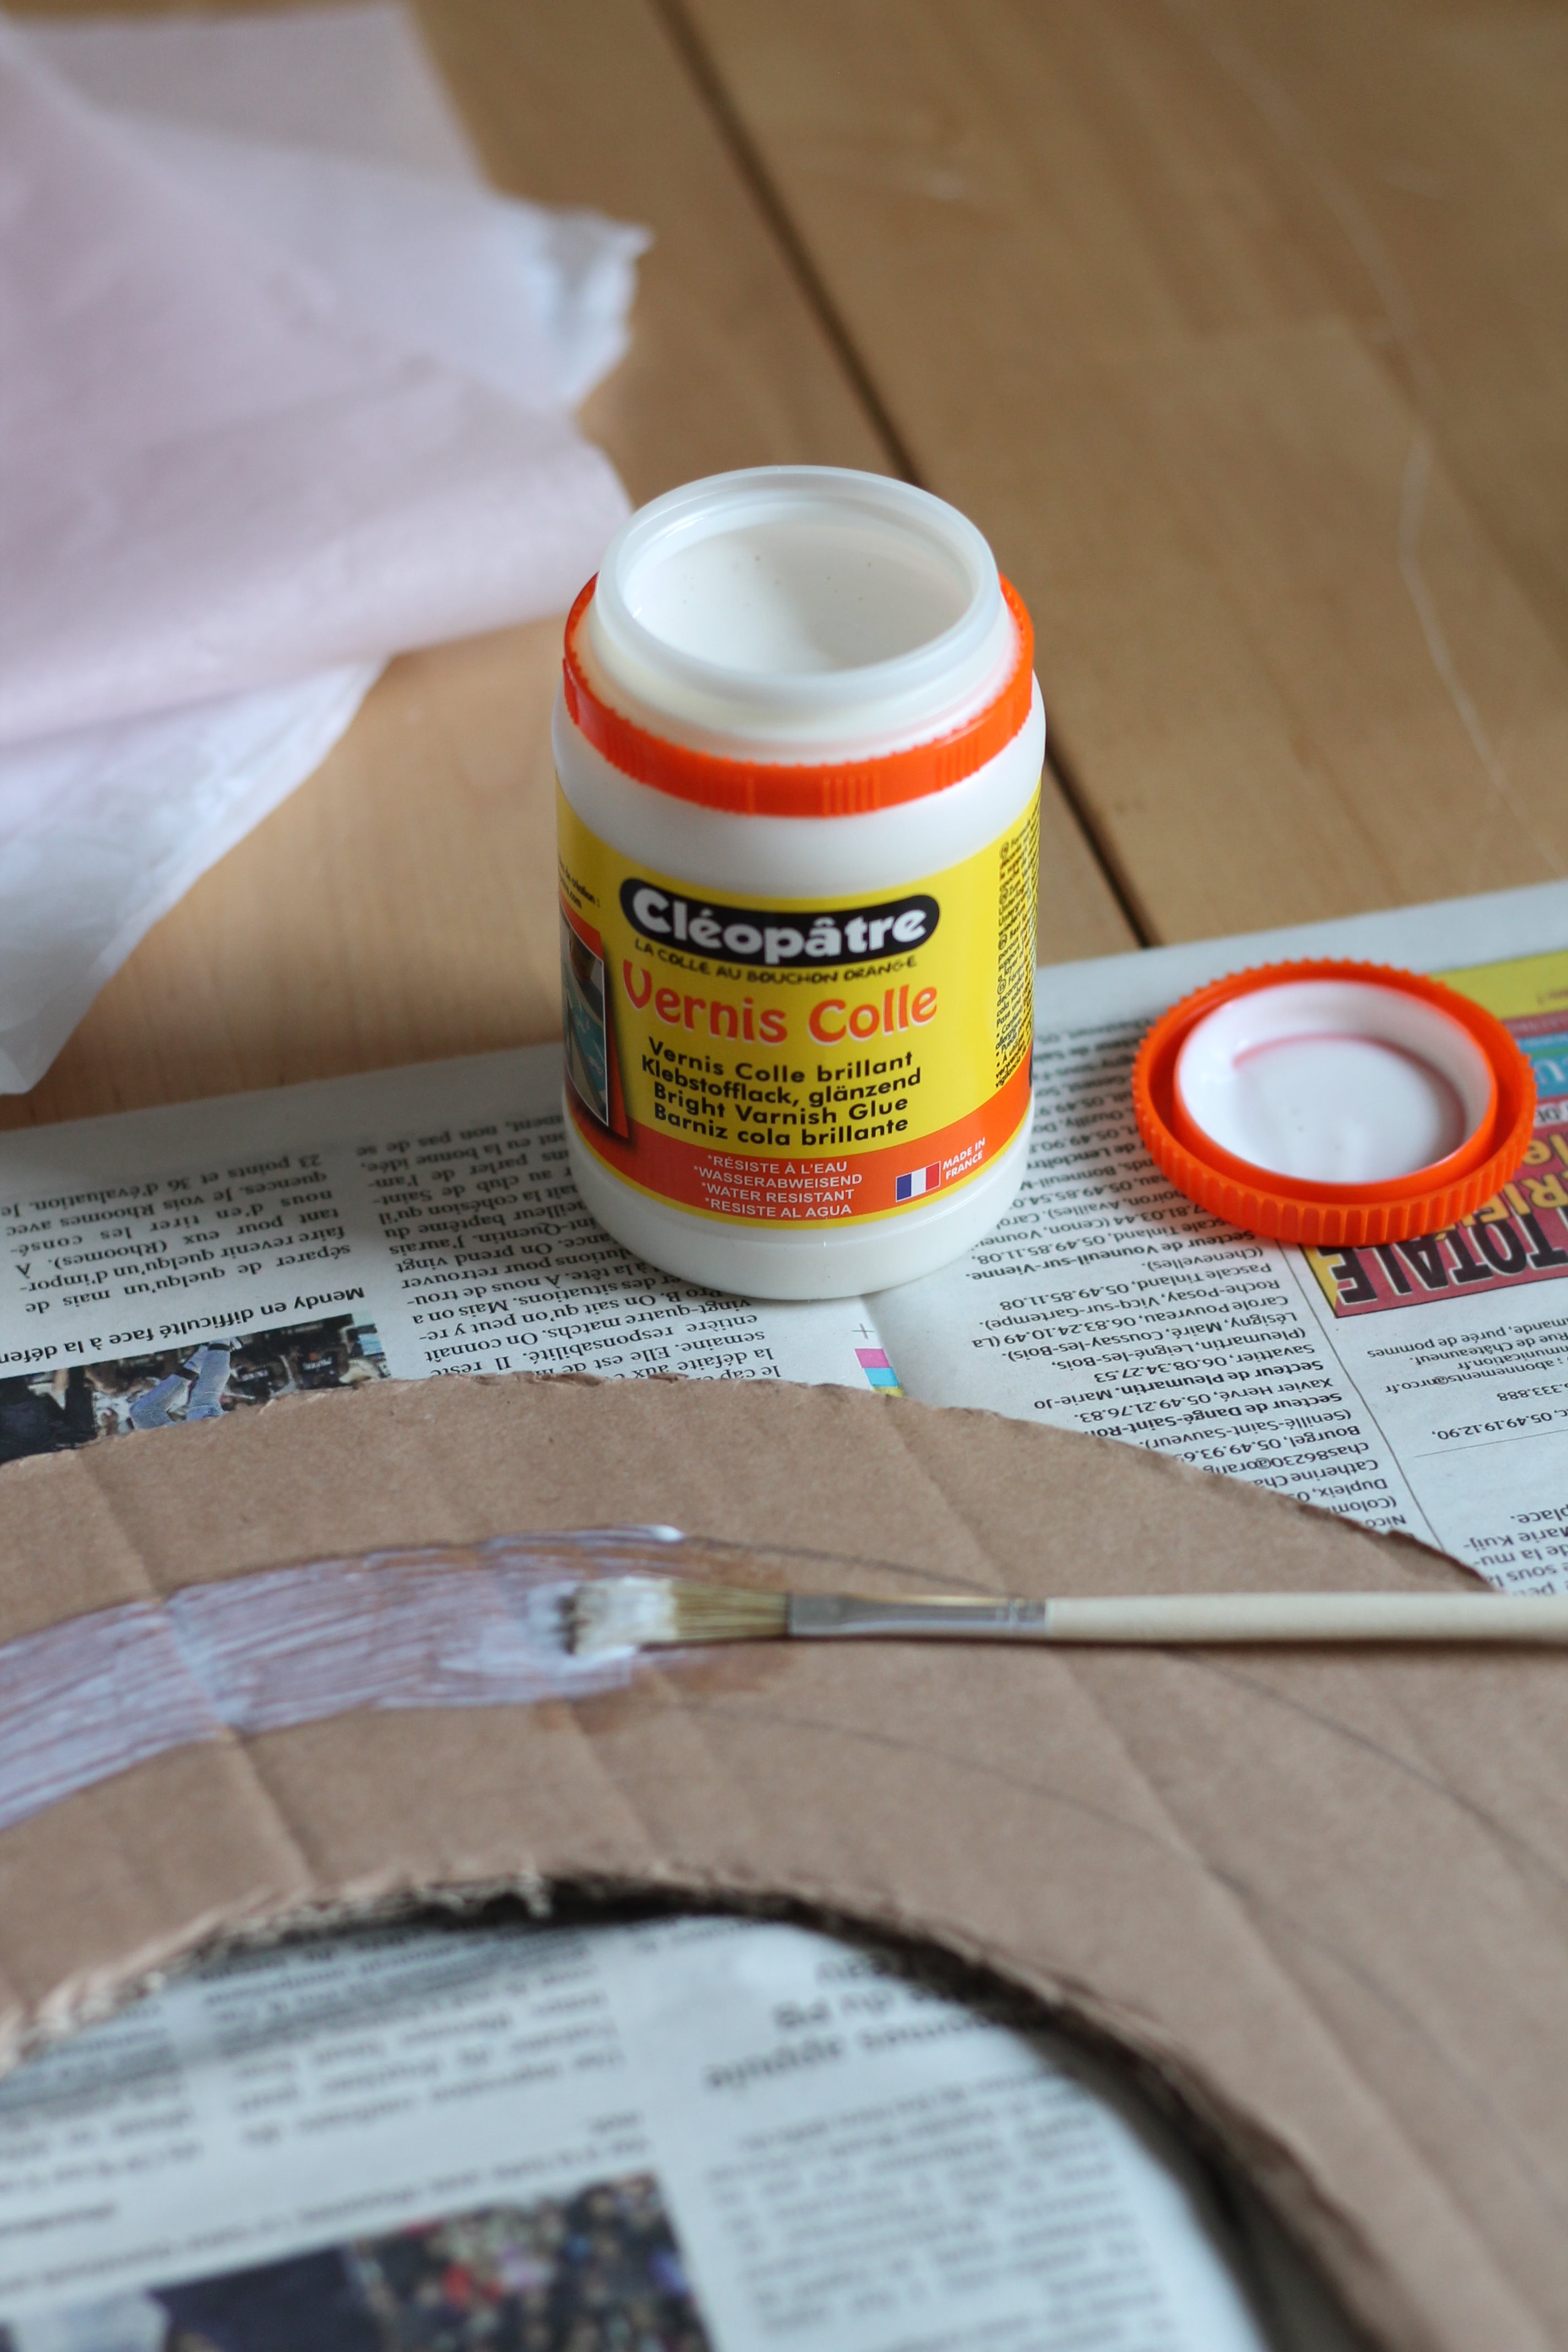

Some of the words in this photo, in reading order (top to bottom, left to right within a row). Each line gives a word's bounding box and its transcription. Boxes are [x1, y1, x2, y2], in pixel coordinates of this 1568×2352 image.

[633, 888, 927, 965] Cléopâtre
[635, 938, 654, 956] LA
[658, 948, 711, 976] COLLE
[716, 966, 741, 981] AU
[747, 970, 838, 985] BOUCHON
[843, 955, 917, 982] ORANGE
[623, 959, 787, 1046] Vernis
[808, 984, 938, 1046] Colle
[649, 1037, 724, 1076] Vernis
[736, 1062, 805, 1083] Colle
[818, 1051, 912, 1082] brillant
[642, 1054, 799, 1107] Klebstofflack,
[809, 1067, 921, 1107] glänzend
[655, 1081, 725, 1118] Bright
[735, 1104, 836, 1125] Varnish
[849, 1098, 908, 1120] Glue
[655, 1102, 728, 1140] Barniz
[738, 1128, 790, 1146] cola
[802, 1119, 908, 1146] brillante
[943, 1146, 972, 1170] MADE
[974, 1136, 986, 1151] IN
[785, 1162, 796, 1174] À
[801, 1161, 848, 1174] L'EAU
[945, 1150, 983, 1180] FRANCE
[766, 1189, 854, 1203] RESISTANT
[780, 1207, 801, 1218] AL
[805, 1204, 852, 1218] AGUA
[237, 1215, 284, 1235] pour
[299, 1226, 345, 1242] faire
[183, 1231, 220, 1245] eux
[1162, 1242, 1183, 1252] de
[48, 1239, 167, 1270] (Rhoomes).
[221, 1236, 293, 1259] revenir
[276, 1245, 351, 1267] séparer
[455, 1244, 515, 1267] prend
[113, 1249, 215, 1279] quelqu'un
[238, 1262, 262, 1275] de
[396, 1257, 448, 1273] vingt
[504, 1256, 552, 1273] pour
[1206, 1263, 1272, 1280] Pascale
[20, 1271, 108, 1292] d'impor-
[123, 1267, 225, 1295] quelqu'un
[401, 1267, 498, 1290] retrouver
[545, 1274, 560, 1289] À
[565, 1268, 610, 1281] tête.
[1131, 1273, 1204, 1292] Tinland,
[463, 1286, 487, 1298] de
[491, 1278, 541, 1292] nous
[621, 1278, 656, 1290] des
[1161, 1280, 1280, 1303] Roche-Posay,
[62, 1290, 110, 1308] mais
[294, 1287, 364, 1310] Mendy
[407, 1291, 459, 1305] trou-
[513, 1283, 618, 1304] situations.
[624, 1295, 656, 1306] On
[660, 1291, 681, 1302] B.
[26, 1301, 50, 1314] de
[260, 1302, 287, 1315] en
[458, 1299, 508, 1317] Mais
[584, 1300, 619, 1315] sait
[1232, 1296, 1288, 1311] Carole
[520, 1304, 579, 1323] qu'on
[1139, 1303, 1230, 1323] Pouvreau,
[1224, 1312, 1297, 1328] Lésigny,
[159, 1309, 254, 1339] difficulté
[471, 1313, 517, 1333] peut
[542, 1317, 621, 1340] matchs.
[686, 1315, 758, 1332] entière
[1166, 1321, 1223, 1339] Mairé,
[109, 1328, 154, 1344] face
[505, 1332, 538, 1345] On
[675, 1331, 765, 1352] semaine.
[971, 1336, 1000, 1348] (La
[1195, 1327, 1306, 1351] (Pleumartin,
[1438, 1337, 1457, 1347] de
[1461, 1326, 1506, 1343] purée
[1516, 1338, 1536, 1348] de
[63, 1341, 84, 1353] la
[424, 1338, 502, 1363] connaît
[630, 1346, 671, 1363] Elle
[753, 1348, 774, 1360] la
[1229, 1344, 1315, 1363] Savattier,
[1367, 1338, 1435, 1359] pommes
[1409, 1342, 1513, 1366] Châteauneuf.
[494, 1356, 511, 1370] Il
[594, 1355, 623, 1369] est
[677, 1352, 747, 1370] défaite
[1255, 1360, 1324, 1378] Secteur
[761, 1365, 781, 1378] le
[1227, 1371, 1250, 1381] de
[1115, 1374, 1223, 1400] Pleumartin.
[1213, 1386, 1273, 1402] Hervé,
[1277, 1378, 1333, 1393] Xavier
[1034, 1389, 1113, 1411] Marie-Jo
[1244, 1403, 1268, 1414] de
[1273, 1392, 1342, 1409] Secteur
[1283, 1425, 1361, 1447] Bourgel,
[1291, 1460, 1379, 1482] Catherine
[1312, 1478, 1388, 1498] Dupleix,
